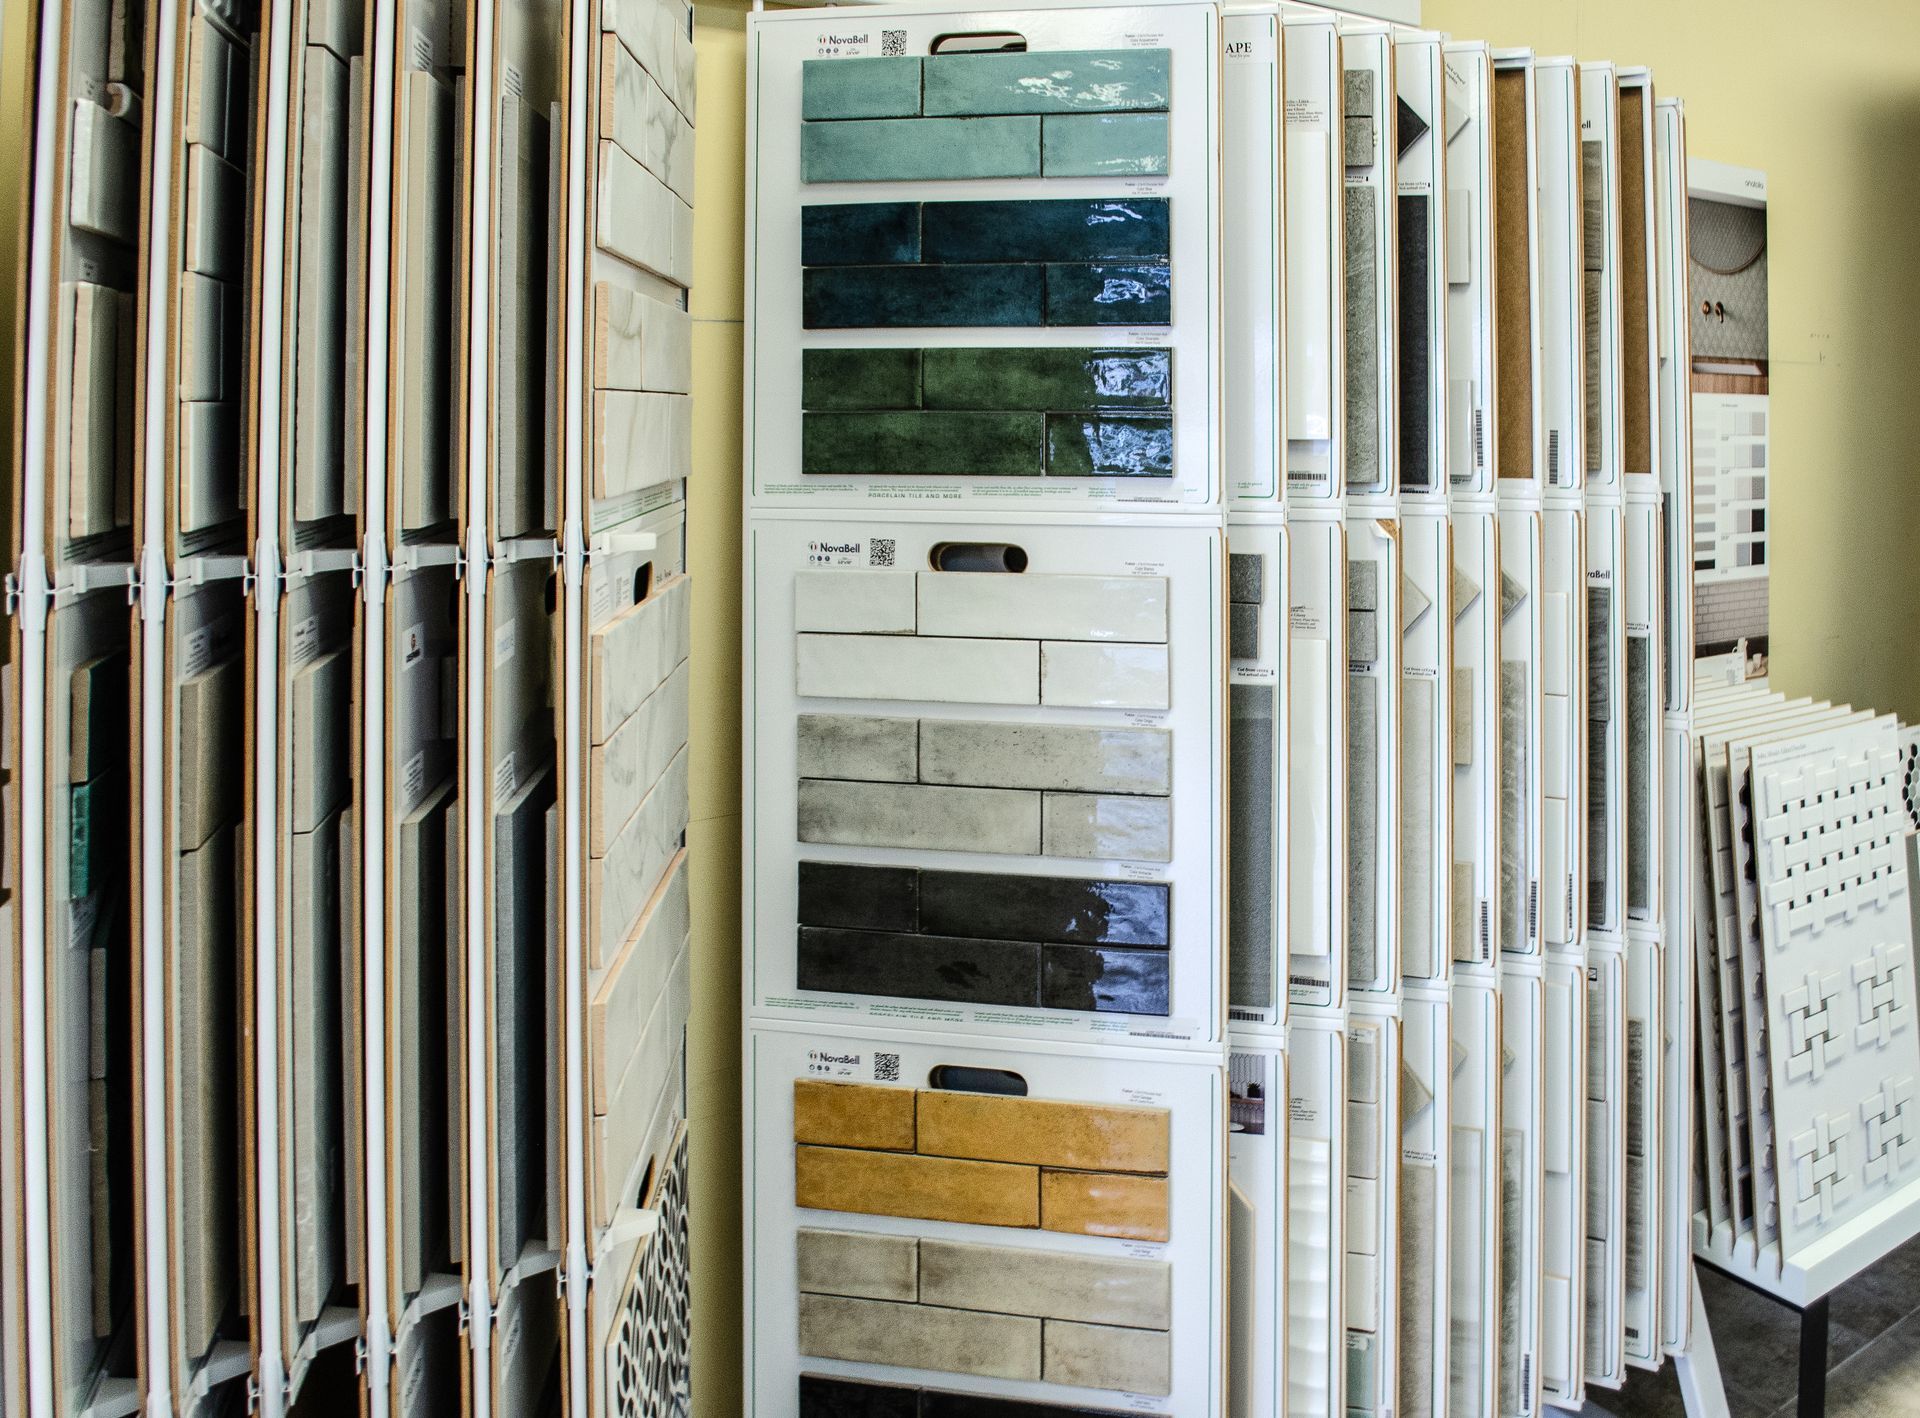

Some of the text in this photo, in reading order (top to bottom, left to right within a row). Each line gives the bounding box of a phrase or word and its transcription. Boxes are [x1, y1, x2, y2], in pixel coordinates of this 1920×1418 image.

[829, 34, 868, 45] NovaBell
[1225, 42, 1252, 53] APE
[820, 542, 860, 553] NovaBell
[1587, 570, 1610, 579] vaBell
[820, 1052, 860, 1065] NovaBell
